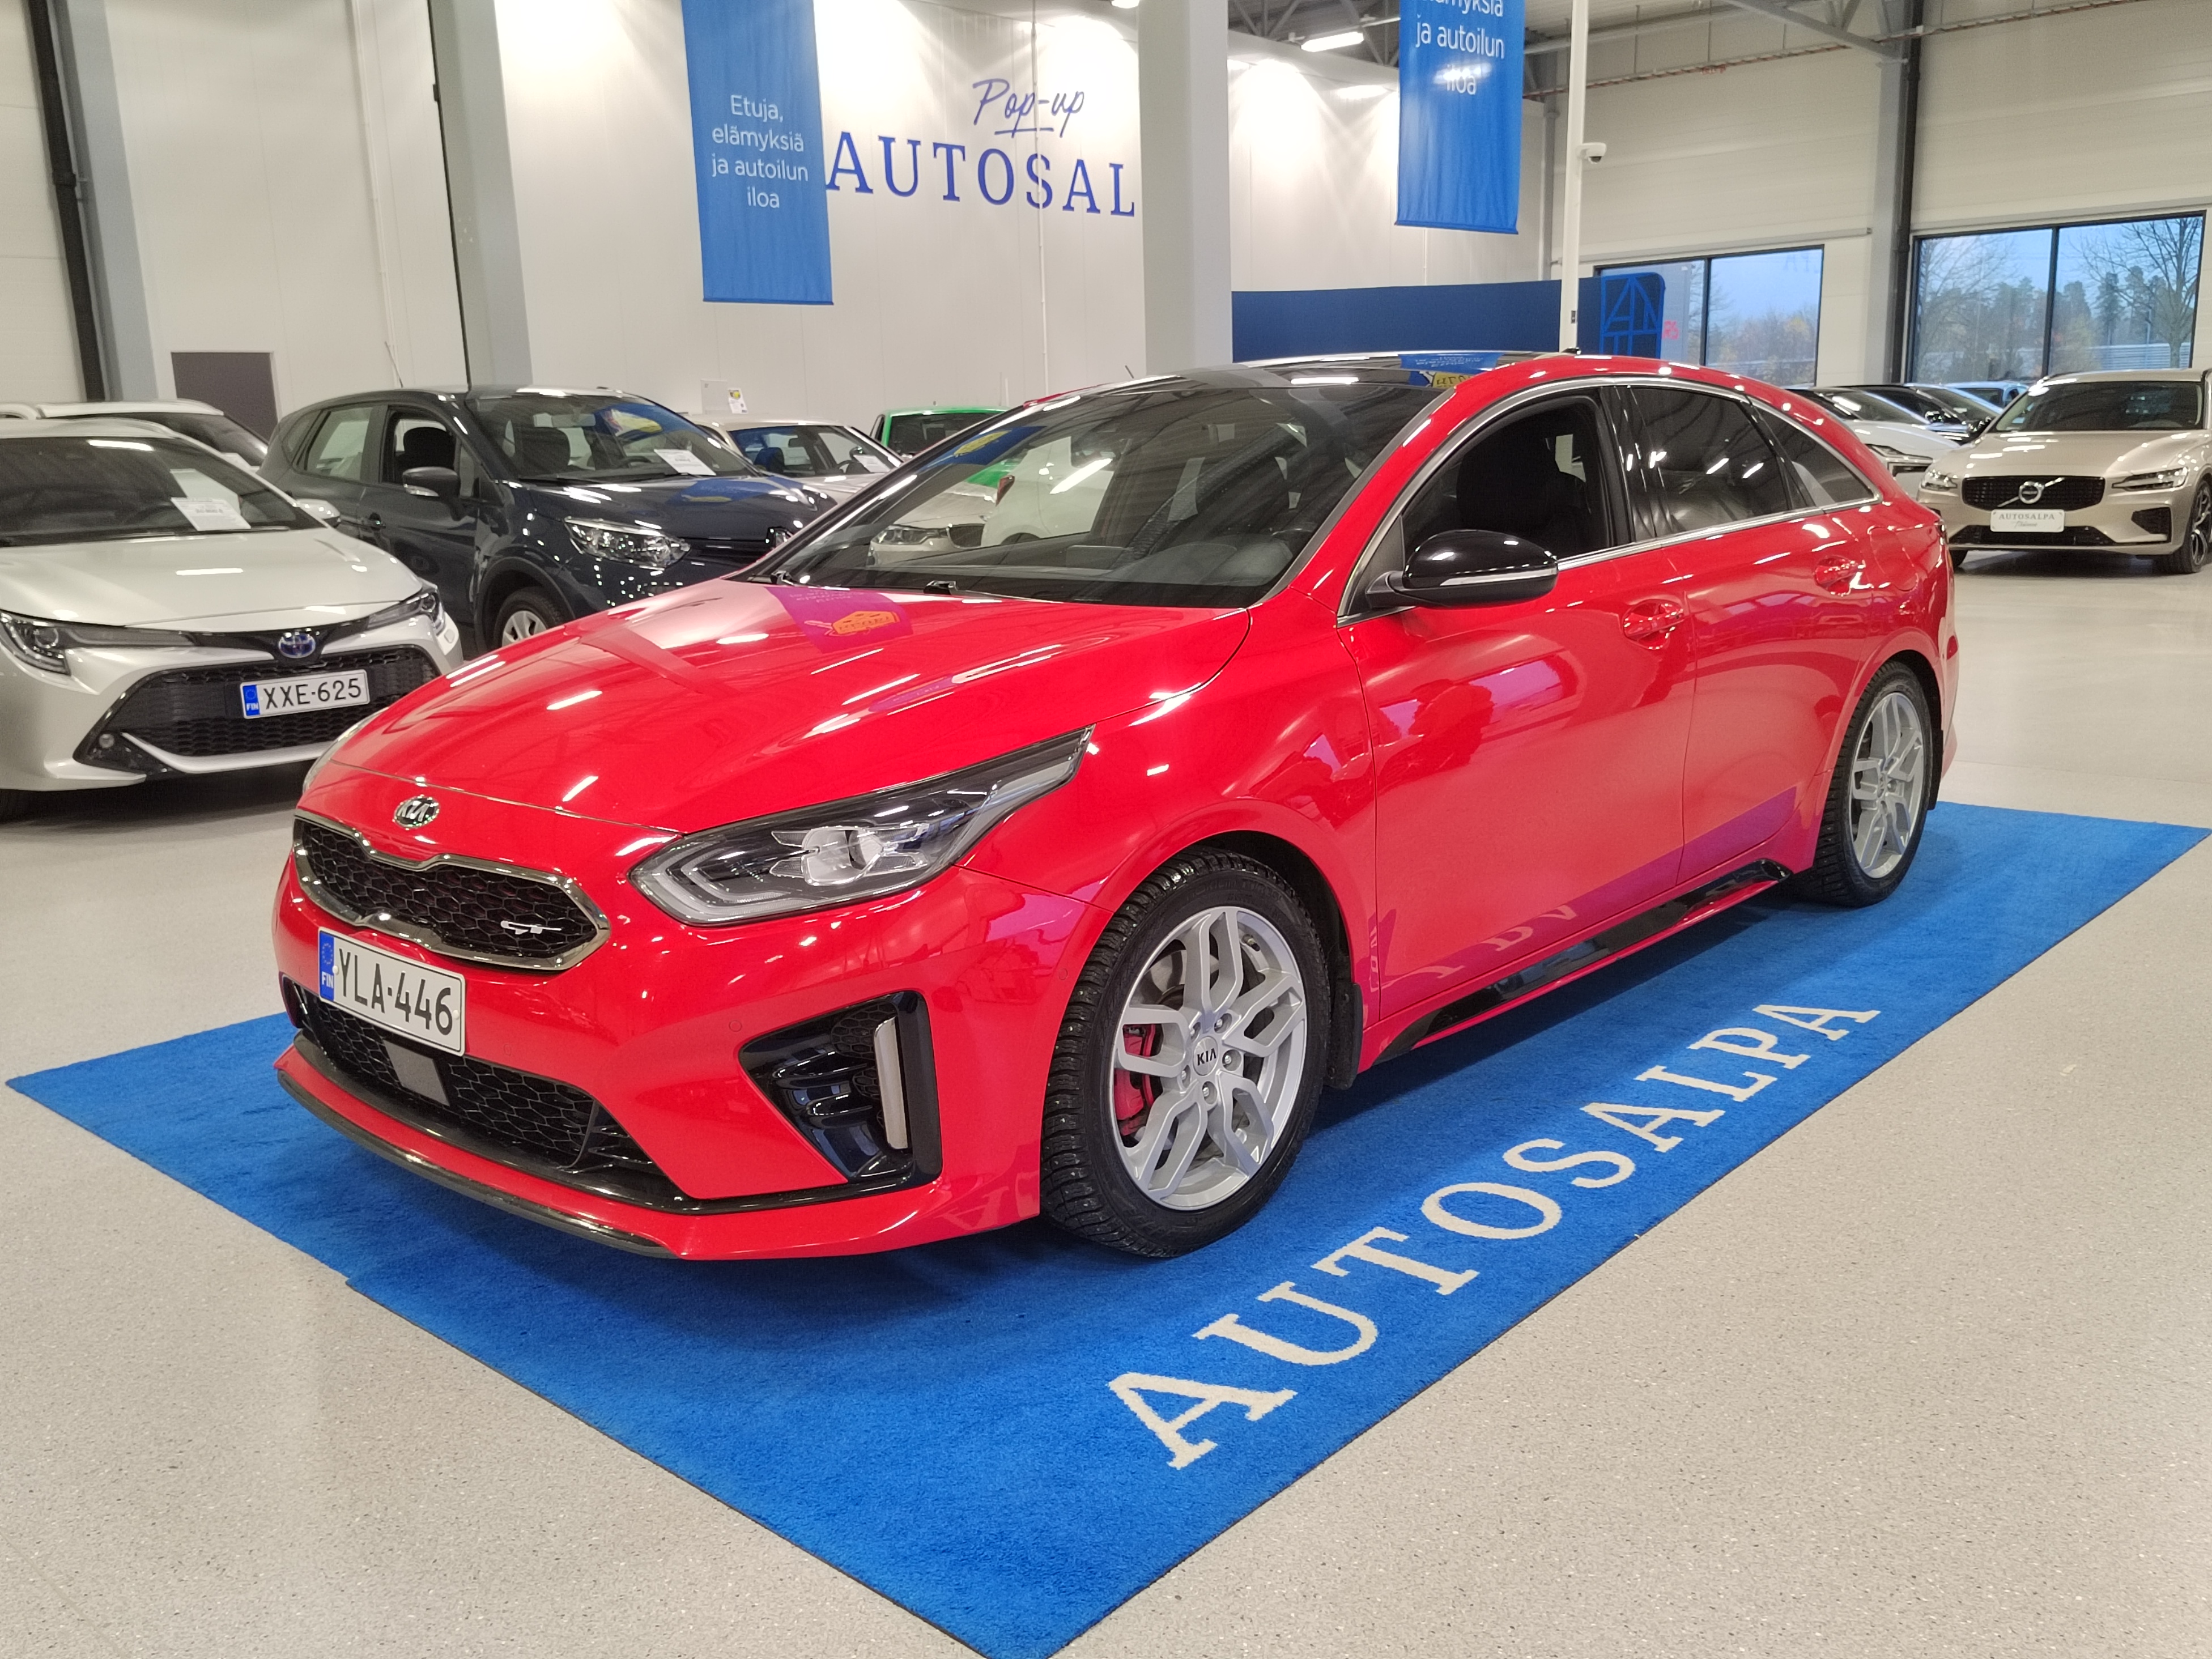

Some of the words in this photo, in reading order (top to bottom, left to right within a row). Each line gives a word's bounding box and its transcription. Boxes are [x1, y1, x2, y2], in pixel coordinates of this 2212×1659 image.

[1415, 14, 1431, 48] ja
[1437, 25, 1504, 59] autoilun
[730, 95, 783, 122] Etuja,
[972, 78, 1084, 138] Pop-up
[712, 124, 803, 152] elämyksiä
[712, 152, 729, 177] ja
[735, 159, 809, 181] autoilun
[747, 186, 780, 208] iloa
[263, 678, 361, 709] XXE-625
[322, 971, 334, 989] FIN
[339, 948, 453, 1036] YLA-446
[1197, 1048, 1216, 1066] KIA
[1109, 1005, 1881, 1470] AUTOSALPA
